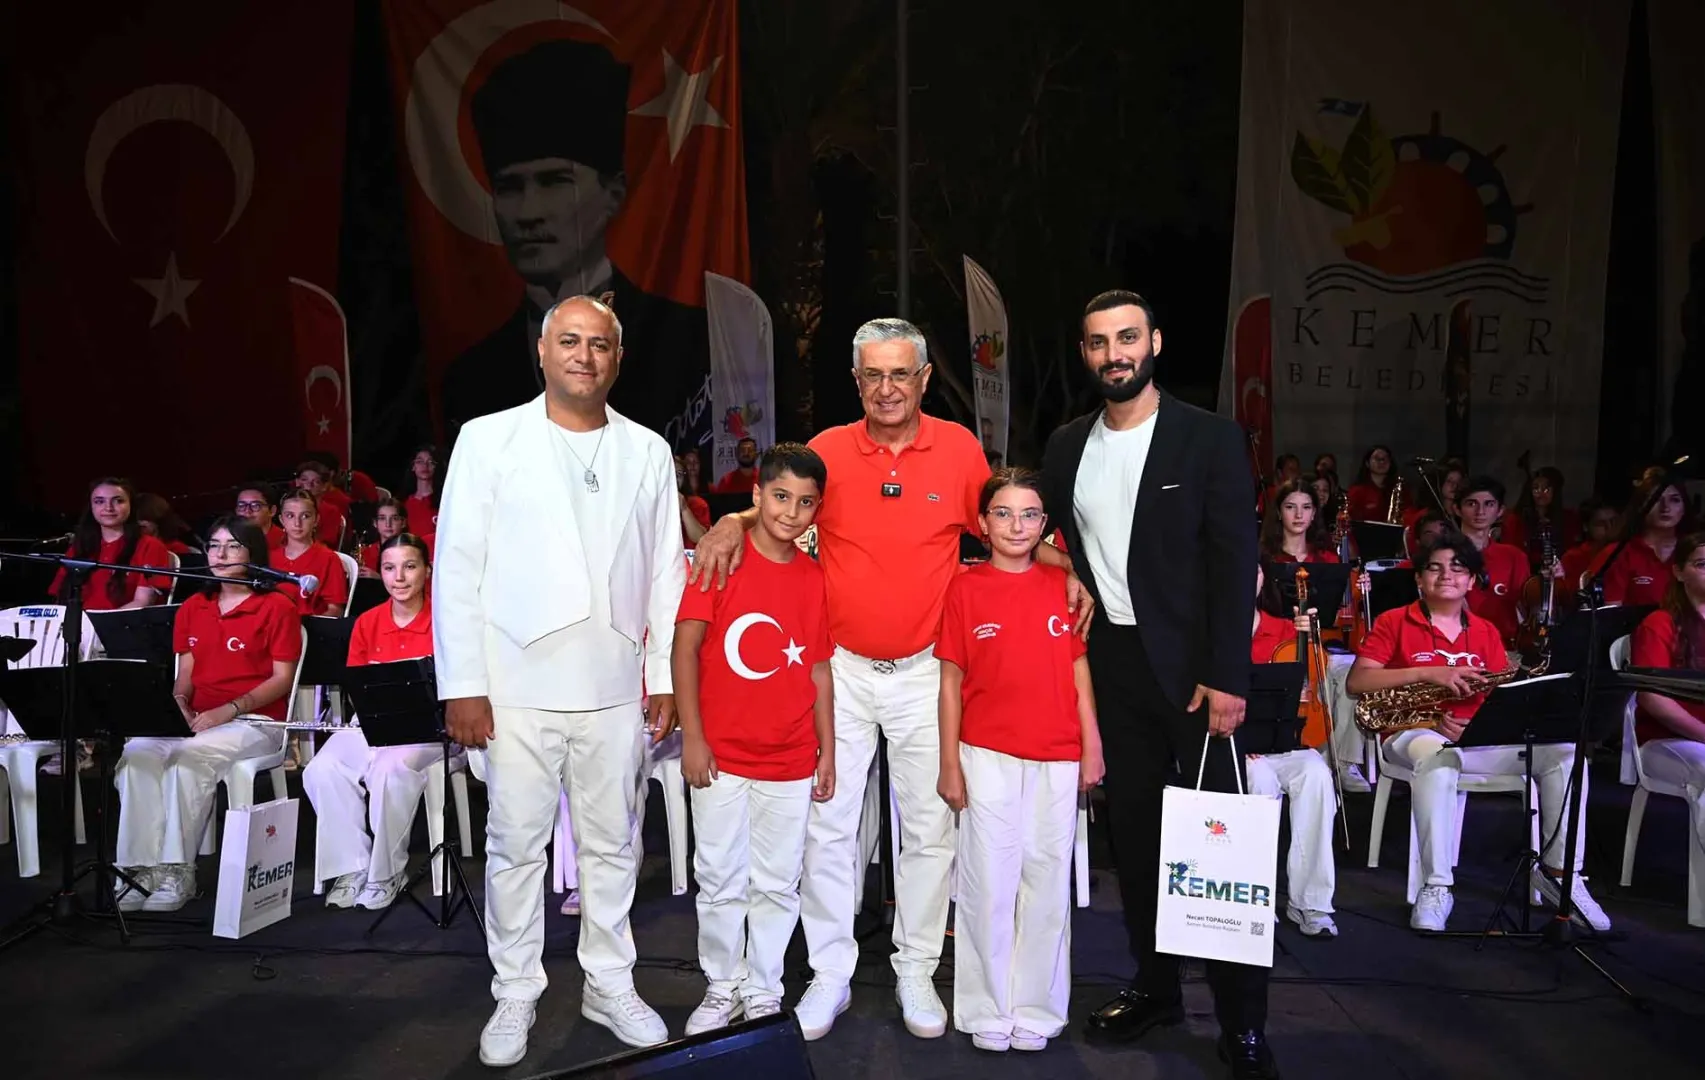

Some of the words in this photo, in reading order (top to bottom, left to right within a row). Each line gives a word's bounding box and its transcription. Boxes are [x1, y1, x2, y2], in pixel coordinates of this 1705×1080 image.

[1293, 306, 1553, 356] KEMER
[247, 861, 293, 892] KEMER
[1168, 874, 1270, 907] KEMER
